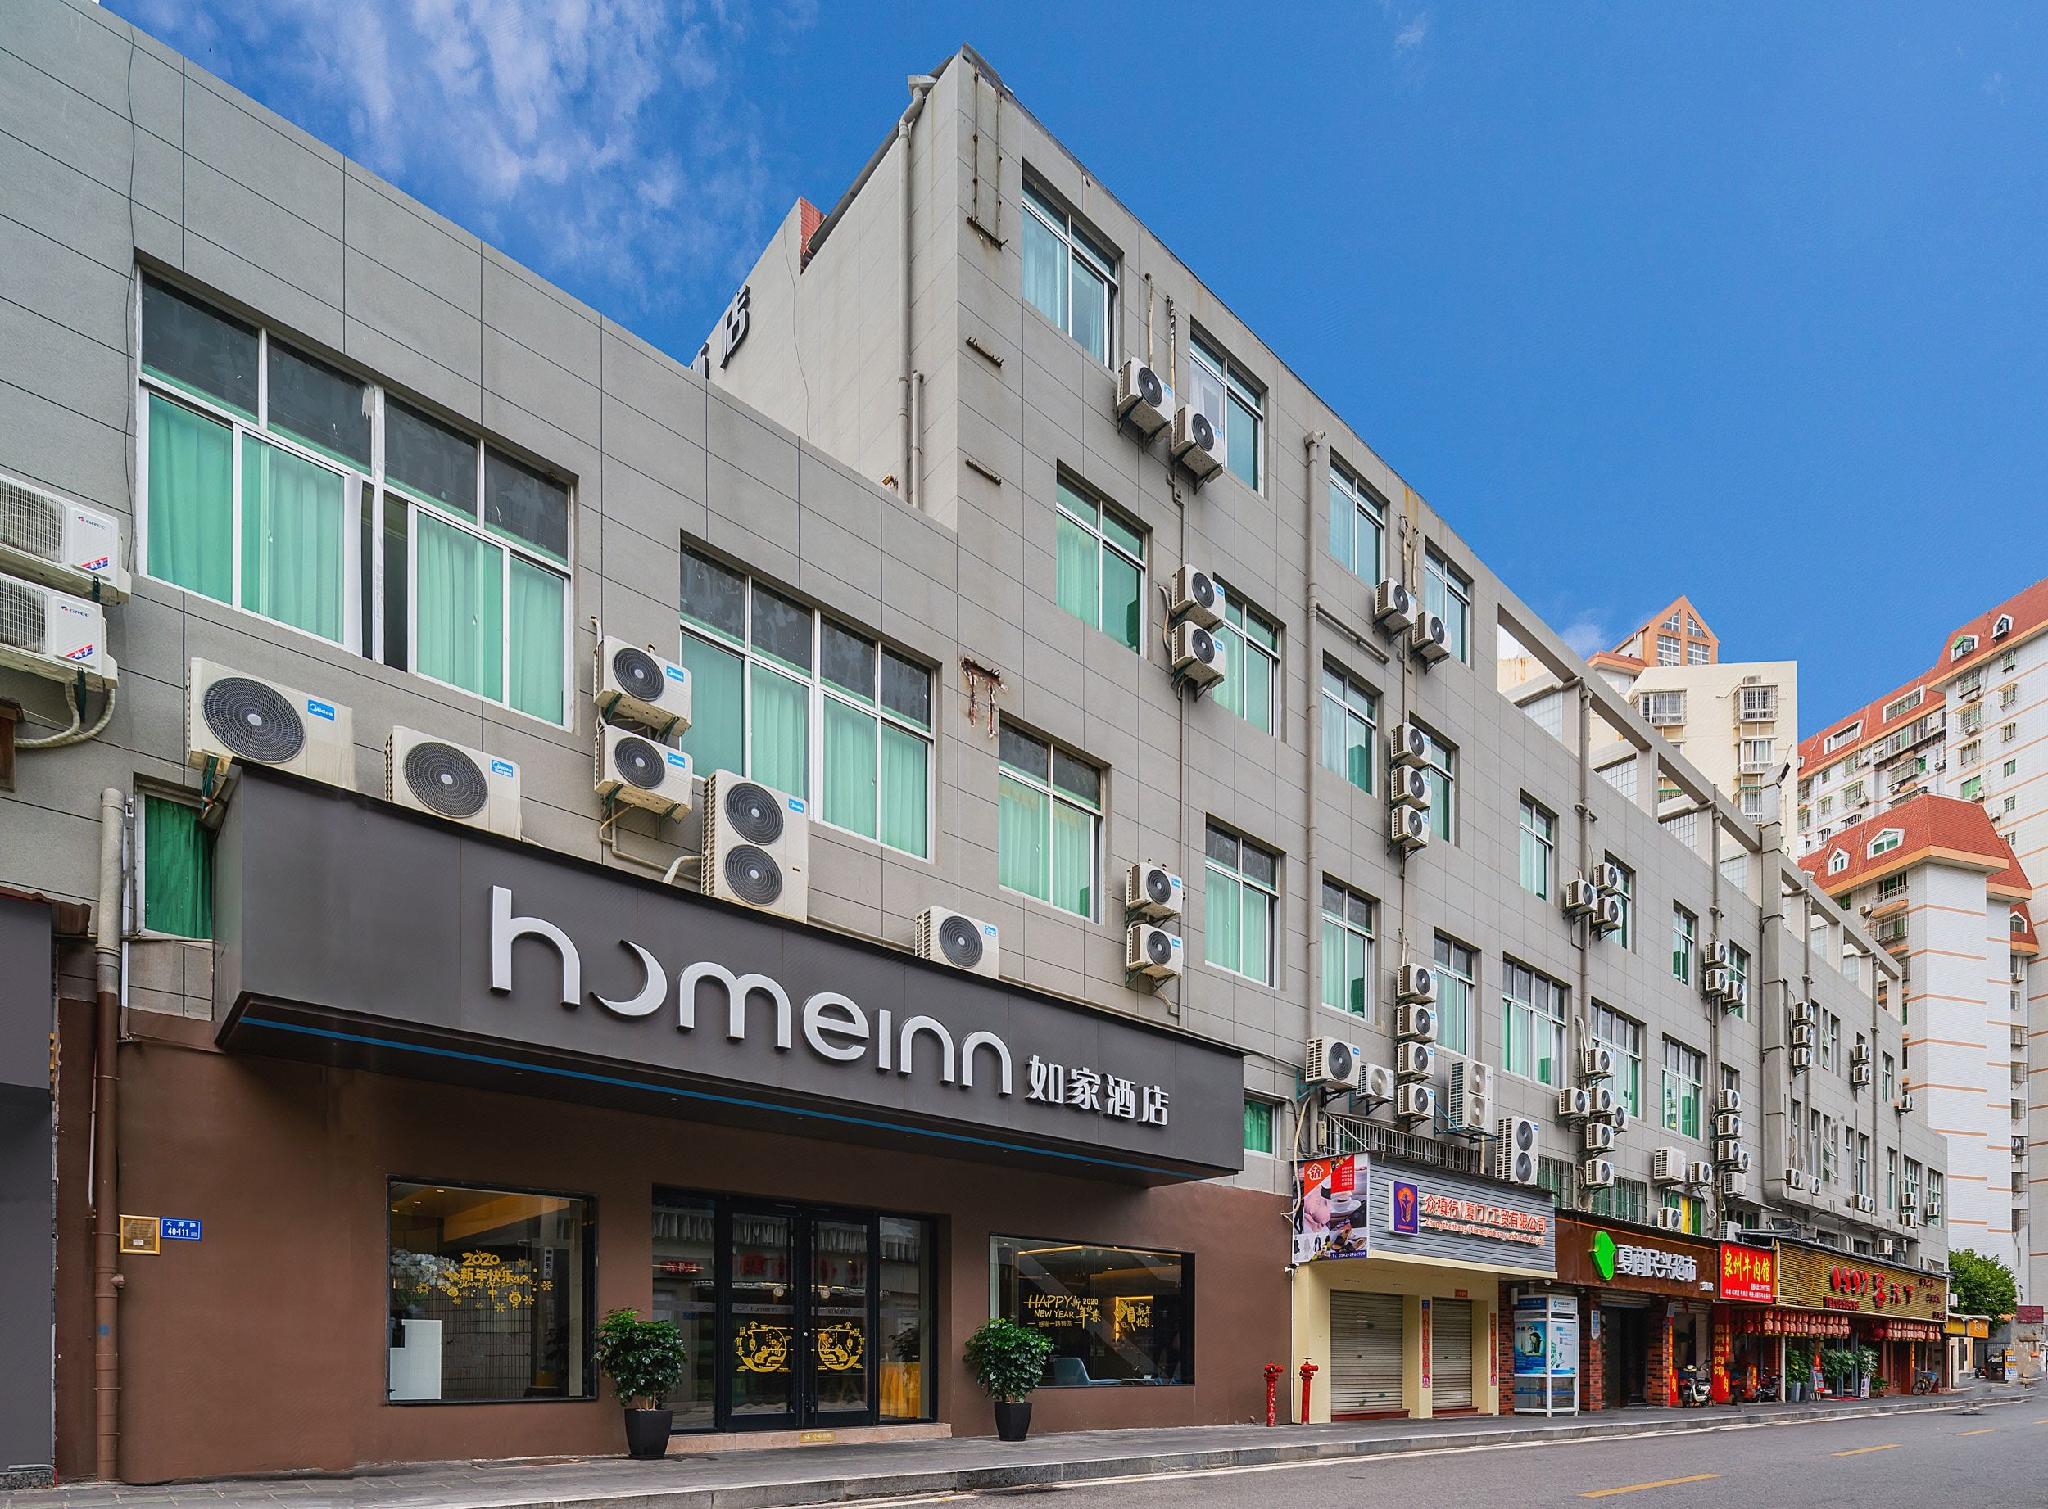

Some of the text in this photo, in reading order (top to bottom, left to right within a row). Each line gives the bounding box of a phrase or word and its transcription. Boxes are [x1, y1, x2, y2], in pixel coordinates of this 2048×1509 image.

[490, 884, 1013, 1095] homeinn
[1025, 1054, 1169, 1126] 如家酒店
[462, 1252, 500, 1267] 2020
[1616, 1245, 1697, 1282] 夏商民兴超市
[460, 1267, 513, 1284] 新年快乐
[1024, 1294, 1073, 1309] HAPPY
[1035, 1309, 1075, 1319] NEW YEAR
